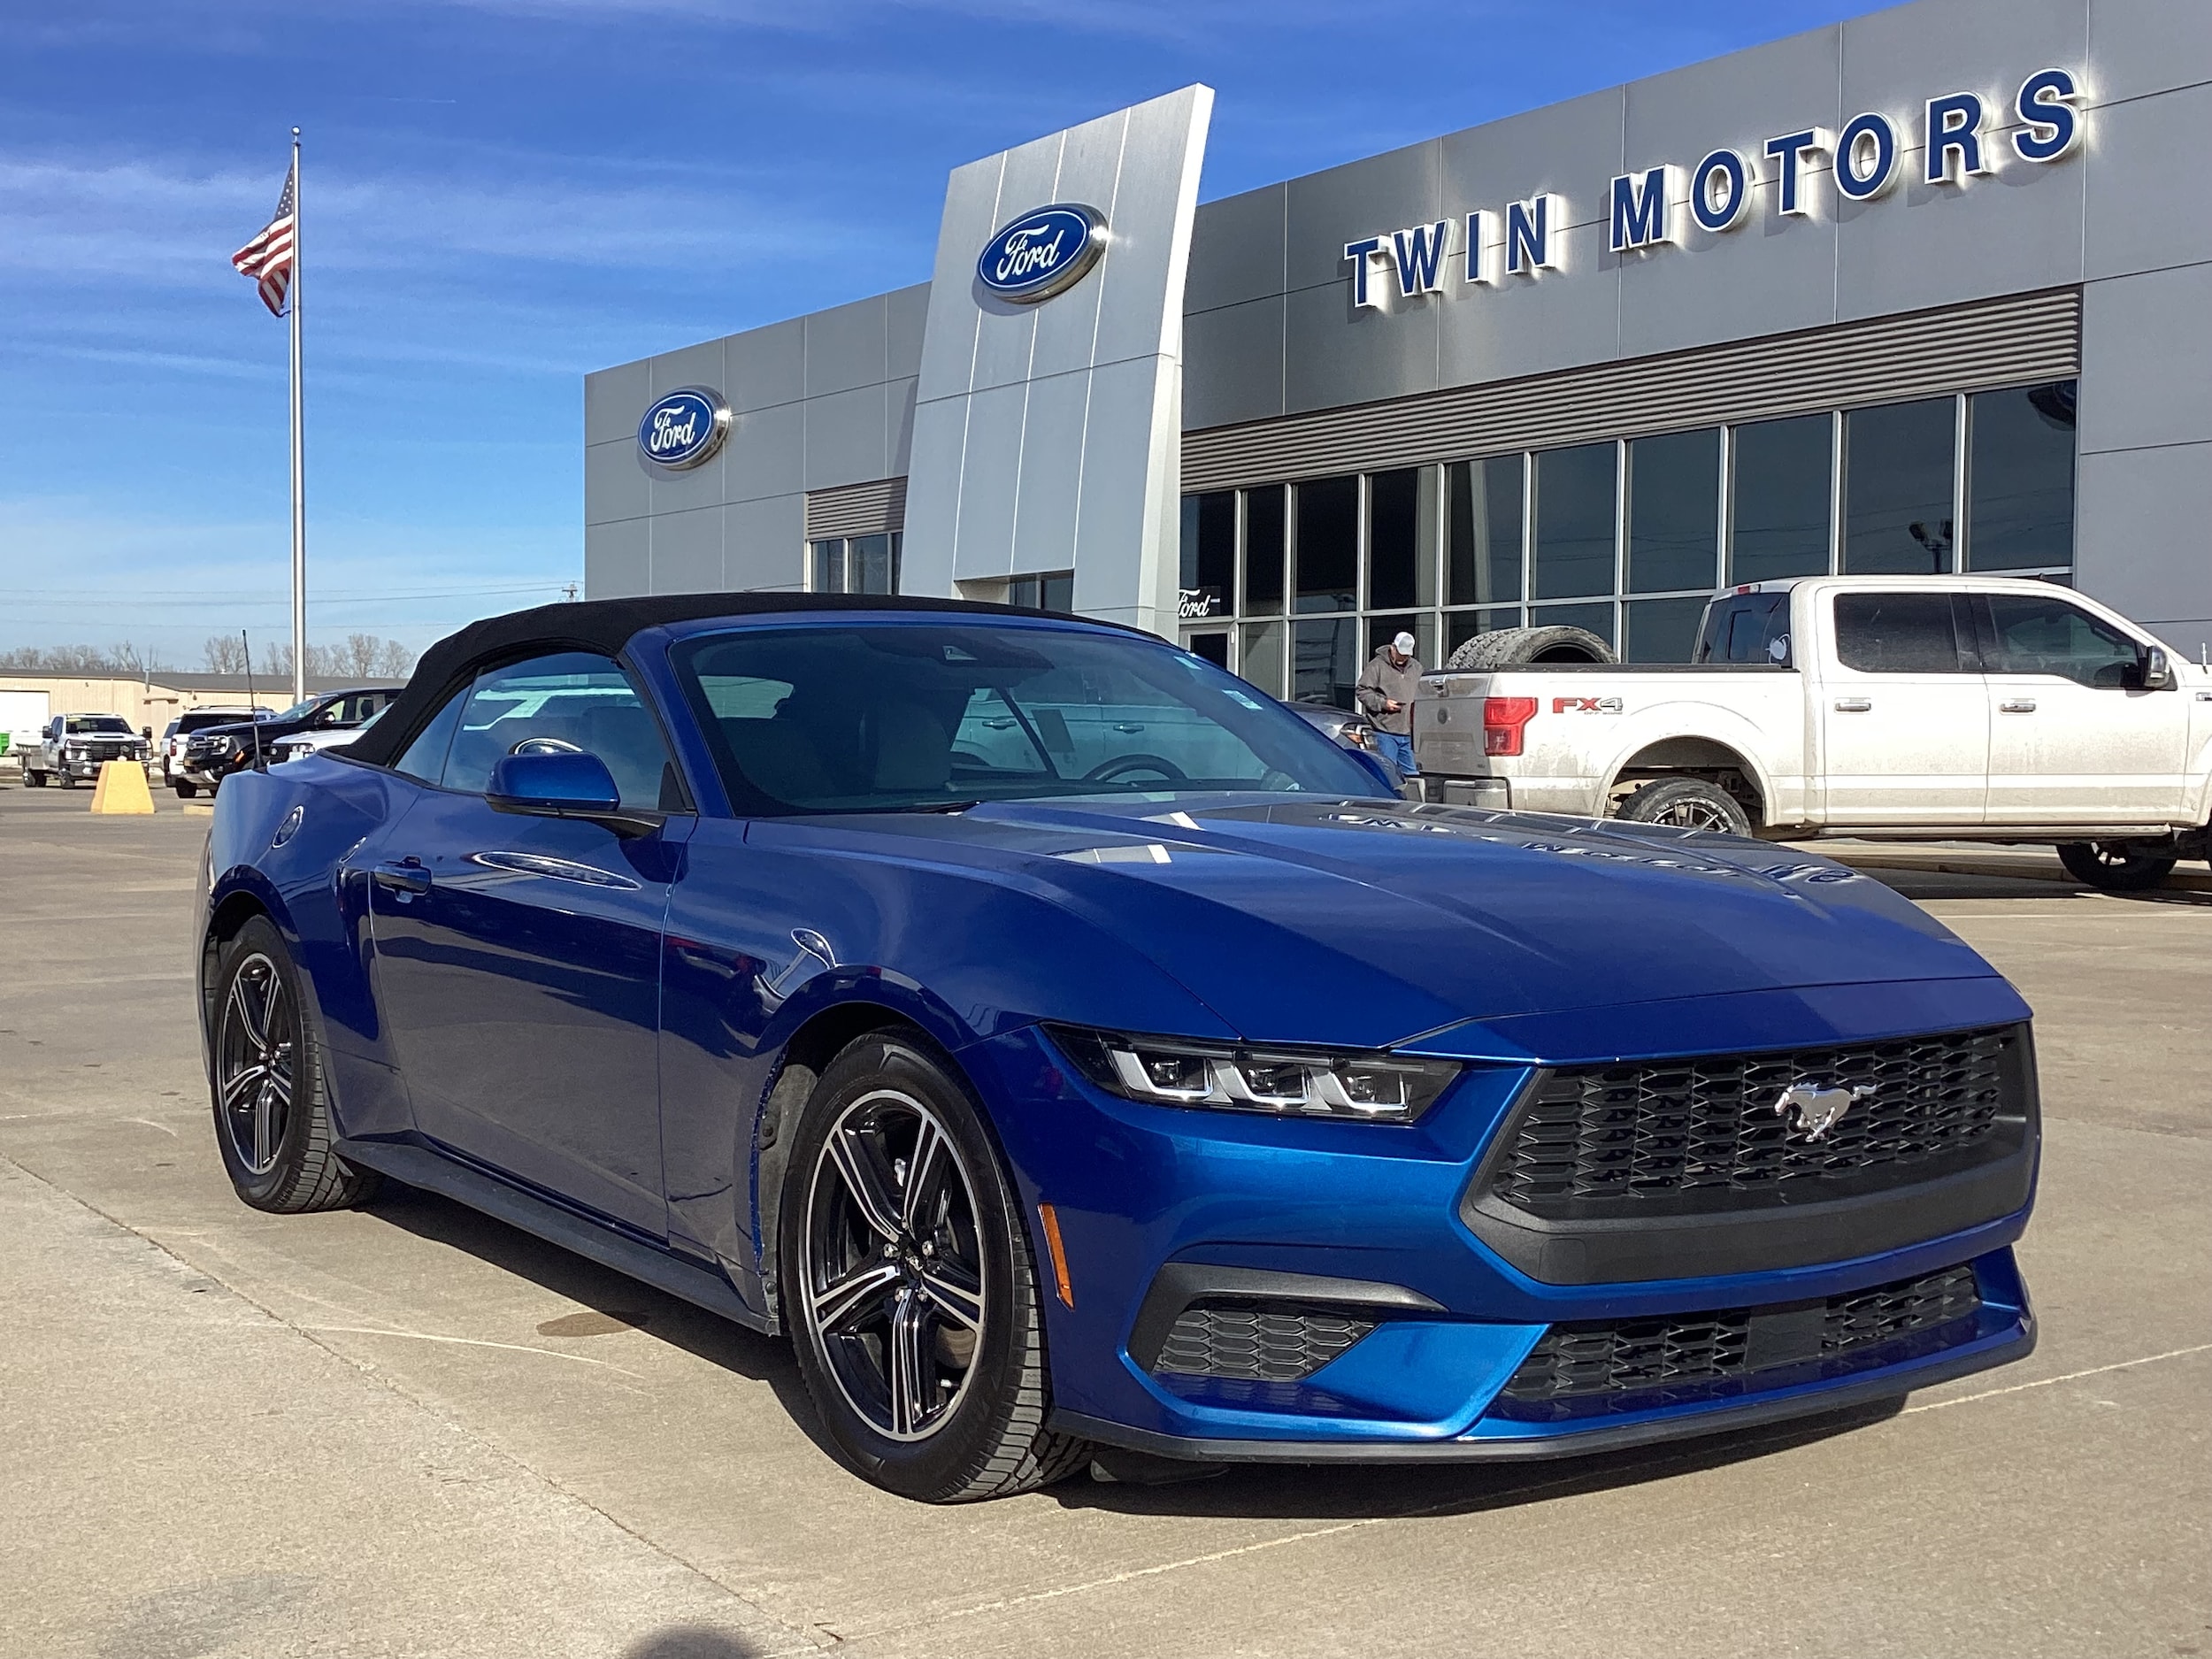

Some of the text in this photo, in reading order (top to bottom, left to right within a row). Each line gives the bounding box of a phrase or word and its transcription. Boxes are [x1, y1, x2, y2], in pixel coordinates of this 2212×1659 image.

[1344, 67, 2084, 308] TWIN MOTORS
[996, 224, 1064, 281] Ford
[650, 405, 696, 452] Ford
[1553, 697, 1623, 713] FX4
